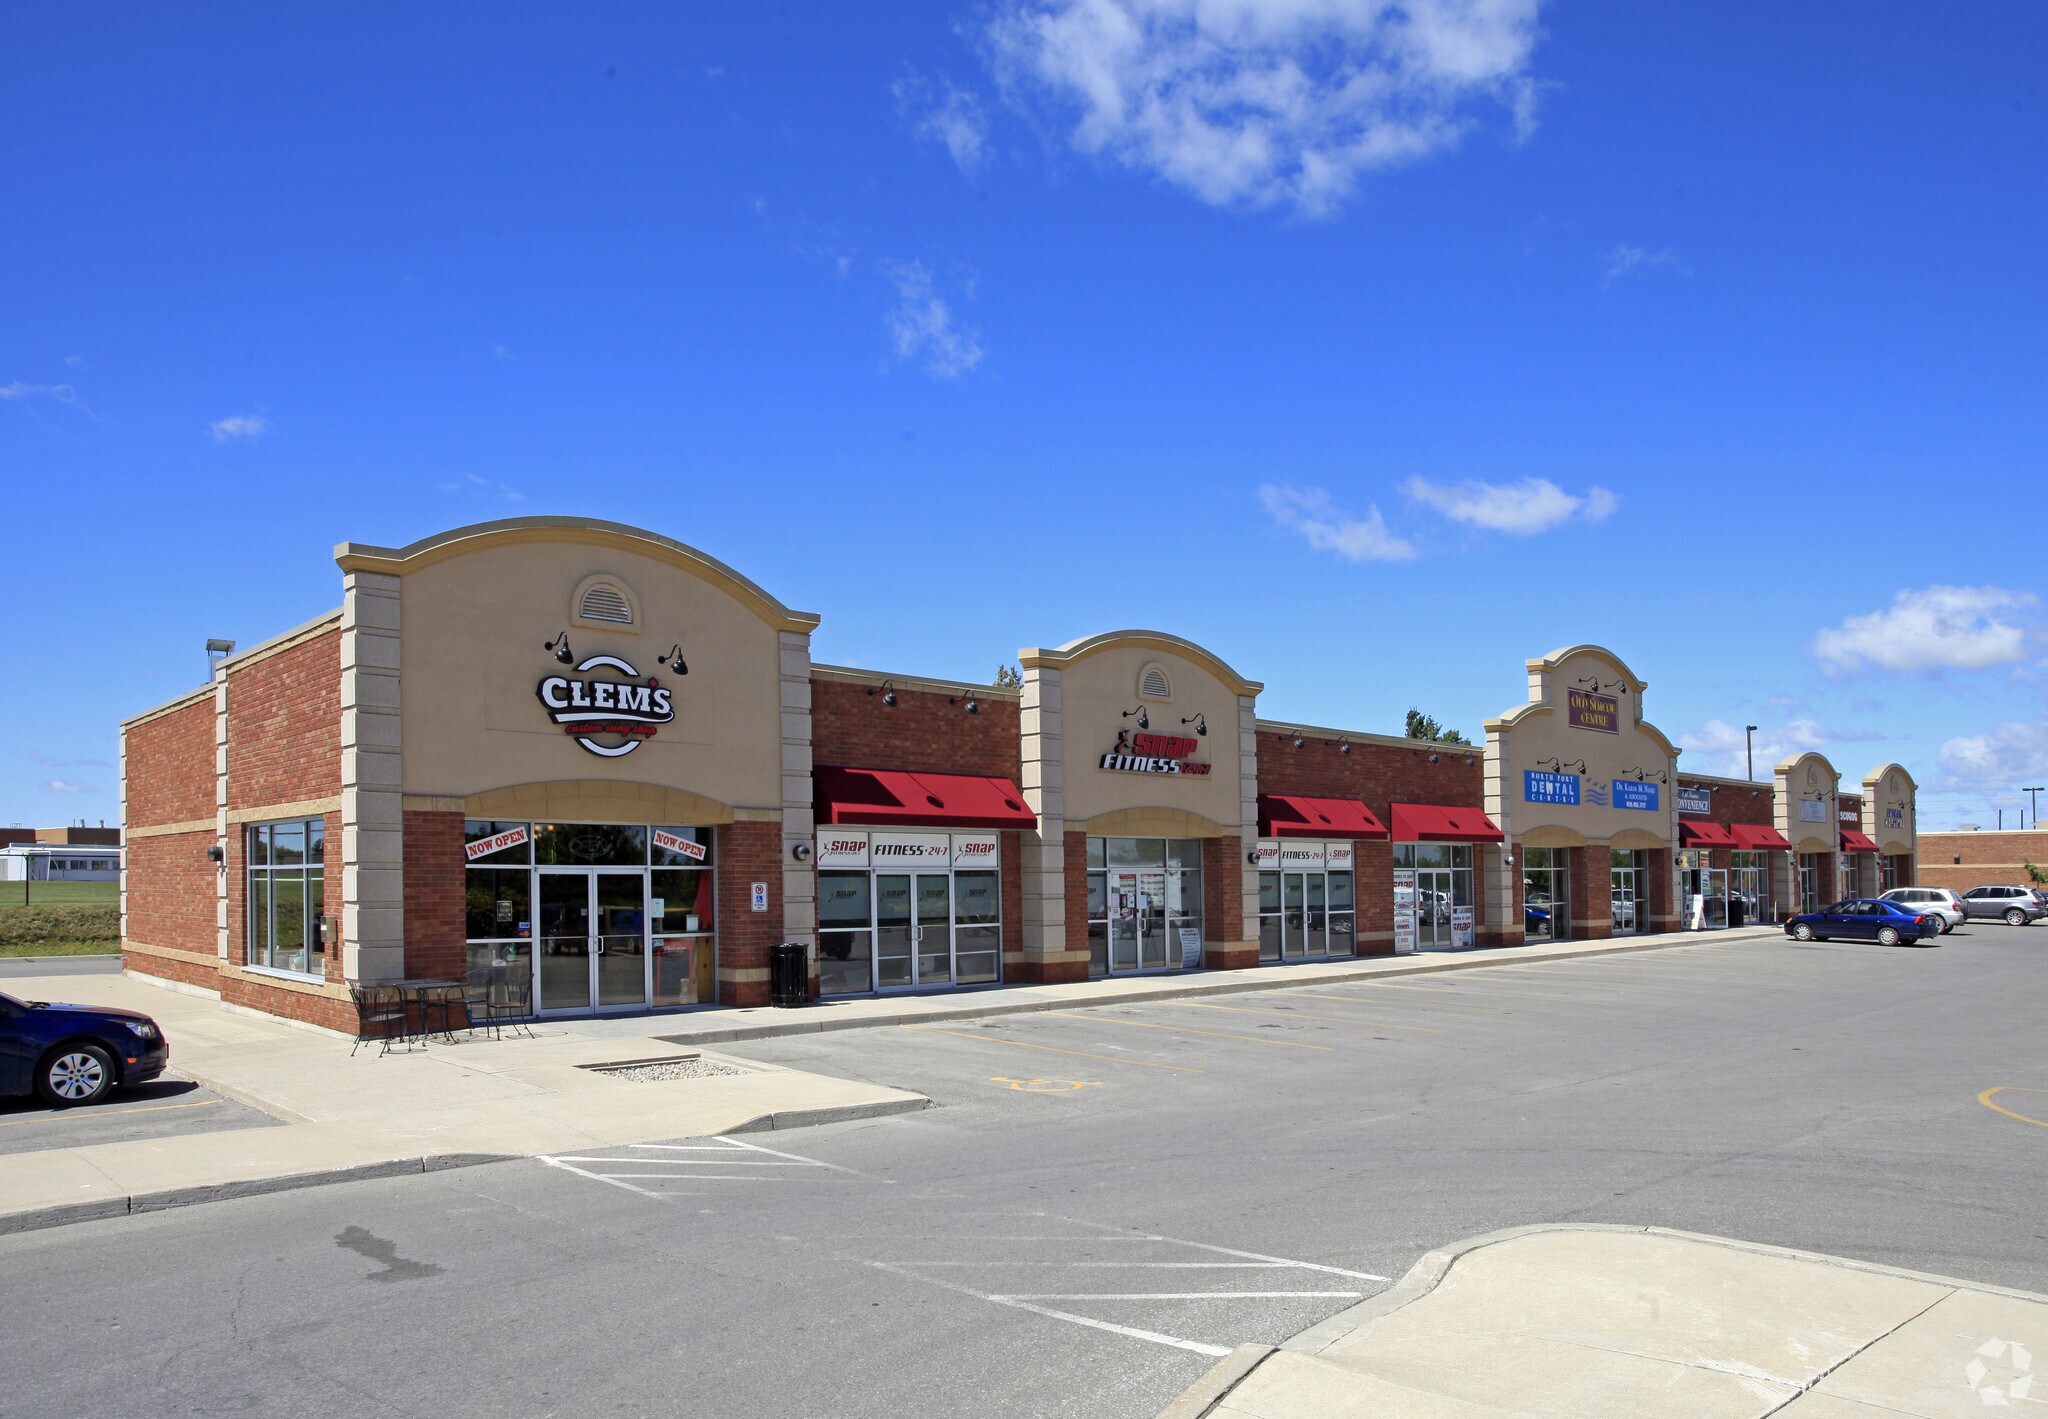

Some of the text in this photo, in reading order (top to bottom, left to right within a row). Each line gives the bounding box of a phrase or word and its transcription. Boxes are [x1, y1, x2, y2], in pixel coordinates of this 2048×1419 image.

[1580, 712, 1609, 727] CENTRE
[565, 723, 604, 735] custom
[633, 723, 658, 739] shop
[1531, 772, 1553, 780] NORTH
[1531, 780, 1574, 795] DENTAL
[1678, 799, 1709, 810] ONVENIENCE
[467, 828, 526, 857] NOW OPEN
[655, 832, 705, 857] NOW OPEN
[874, 844, 924, 856] FITNESS
[1282, 851, 1310, 859] FITNESS
